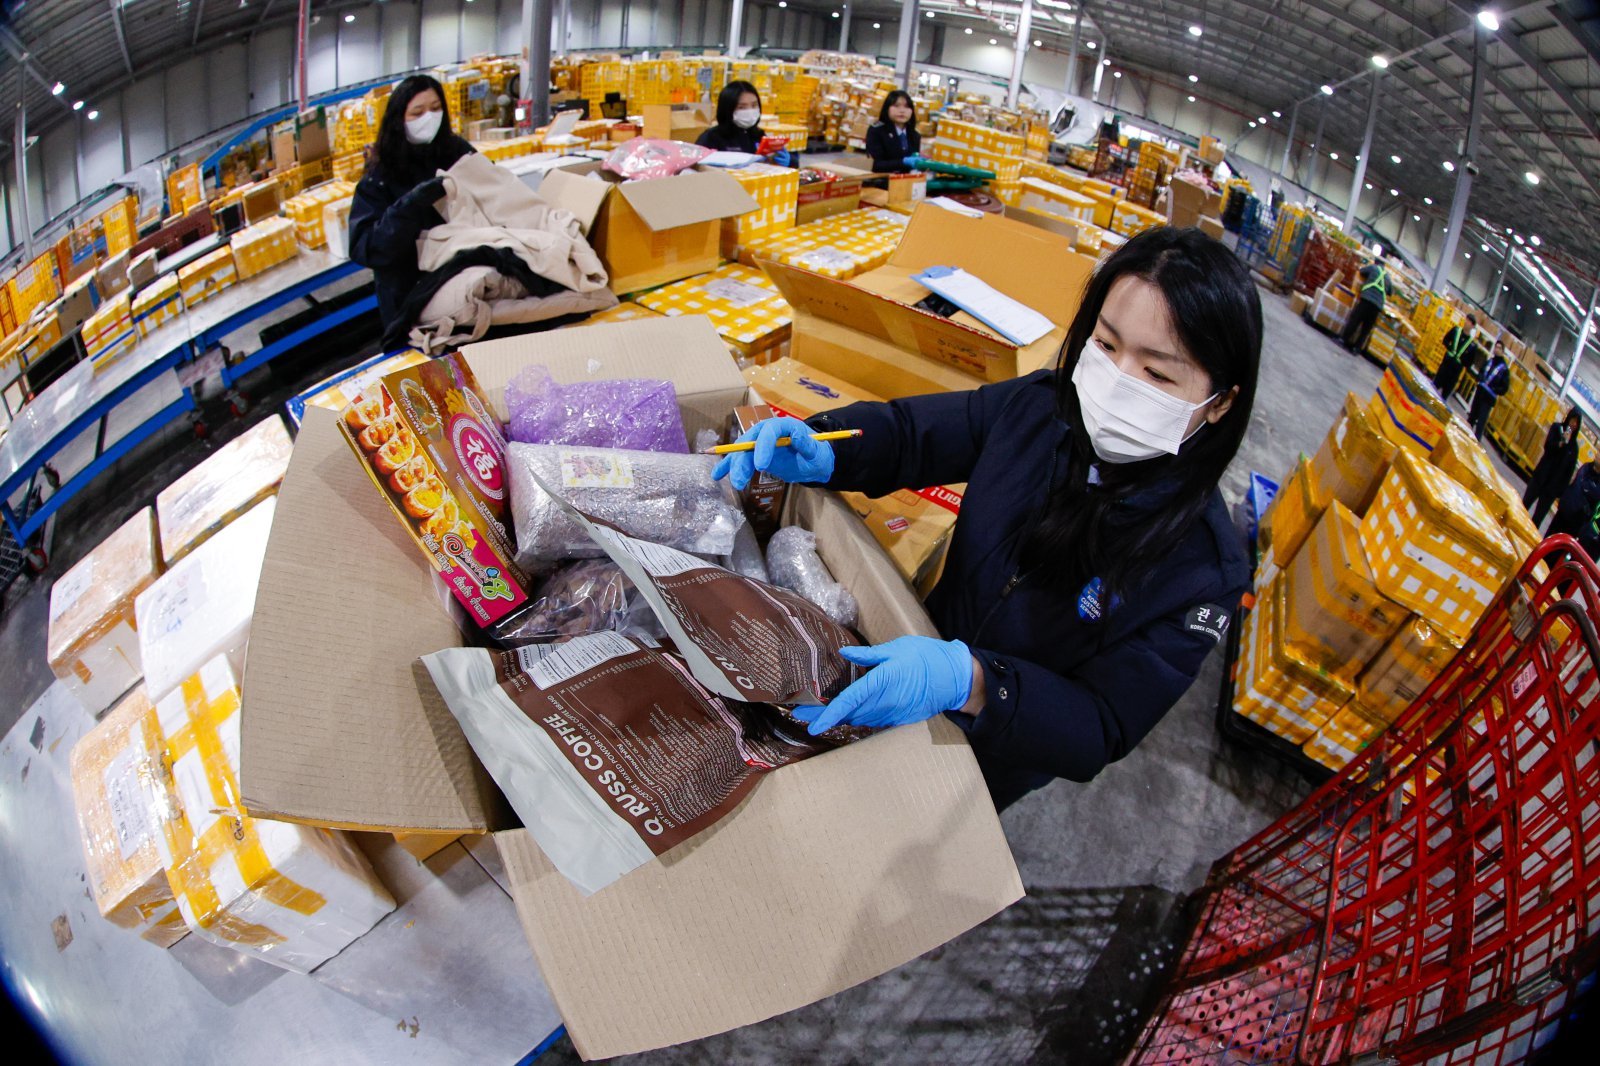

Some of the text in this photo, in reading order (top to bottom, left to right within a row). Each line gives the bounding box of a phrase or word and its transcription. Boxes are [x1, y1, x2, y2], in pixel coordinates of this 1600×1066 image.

[467, 436, 498, 480] 福
[1196, 607, 1229, 634] 관세
[735, 676, 754, 689] Q
[562, 709, 580, 724] COFFEE
[543, 713, 602, 771] COFFEE
[577, 722, 592, 737] RUSS
[593, 739, 617, 764] POWDER
[615, 763, 633, 784] MIXED
[598, 770, 650, 817] RUSS
[631, 783, 654, 802] COFFEE
[651, 801, 675, 829] INSTANT
[656, 786, 686, 825] INGREDIENTS
[644, 817, 664, 836] Q
